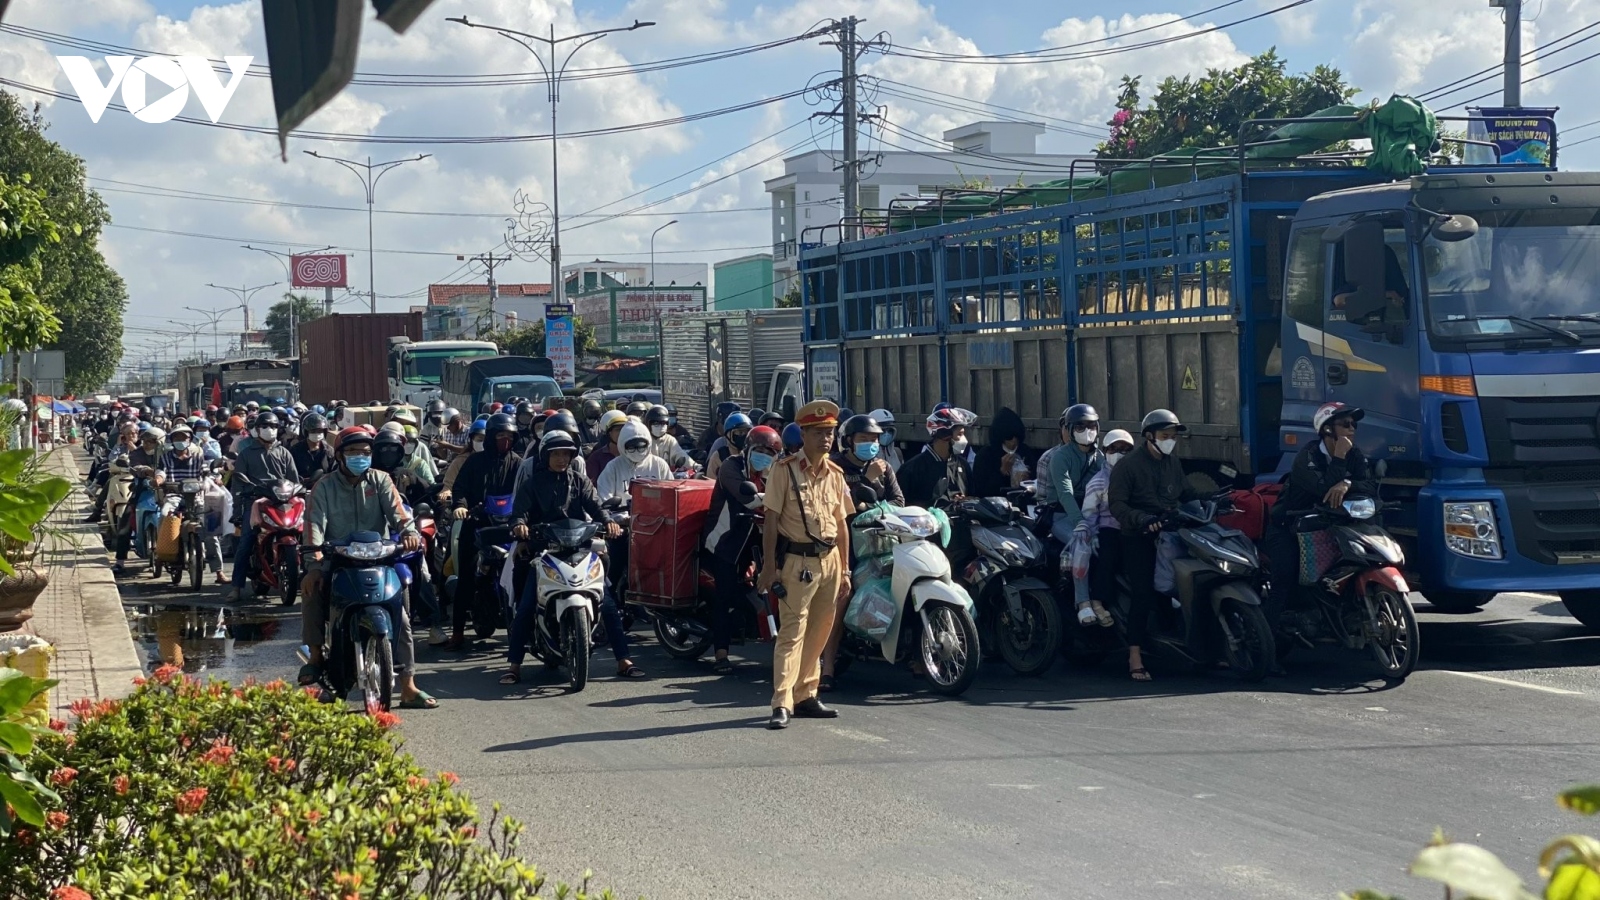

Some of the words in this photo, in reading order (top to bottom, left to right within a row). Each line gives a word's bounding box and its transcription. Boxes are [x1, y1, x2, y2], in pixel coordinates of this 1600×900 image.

[1498, 129, 1514, 140] SÁCH
[297, 257, 341, 284] GO!
[626, 292, 646, 302] PHÒNG
